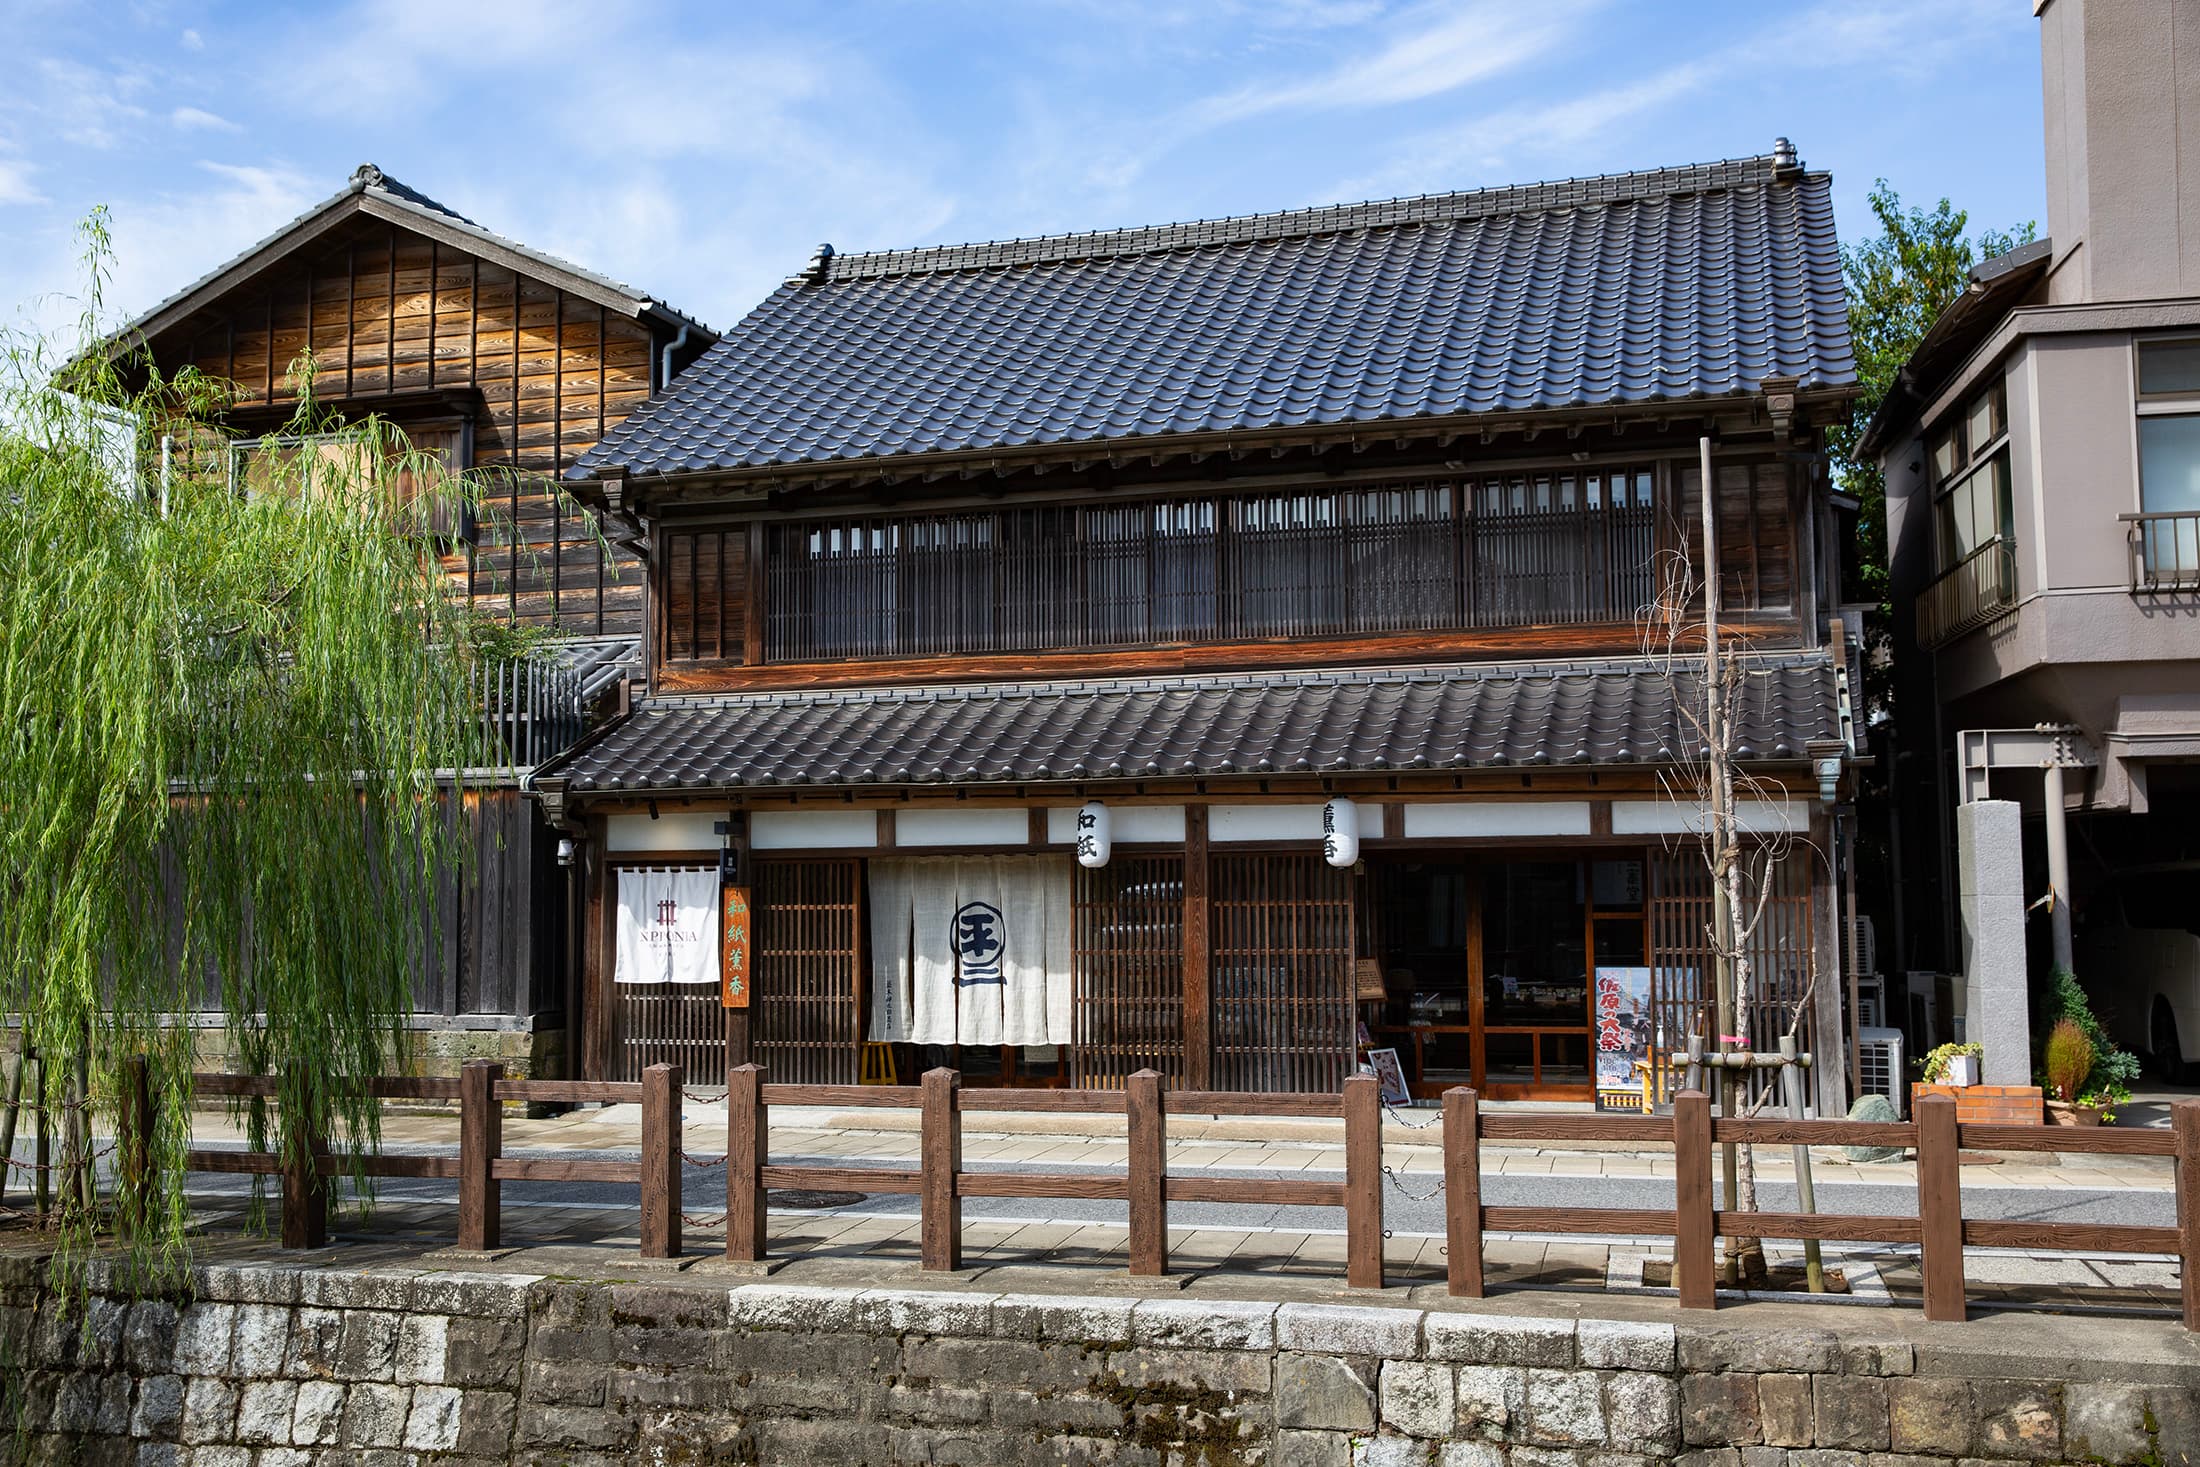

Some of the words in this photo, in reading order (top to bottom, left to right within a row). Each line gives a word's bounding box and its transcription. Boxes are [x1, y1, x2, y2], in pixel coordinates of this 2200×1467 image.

[1076, 809, 1097, 857] 和紙
[727, 899, 748, 996] 和紙薫香
[1598, 977, 1623, 1051] 佐原の大祭
